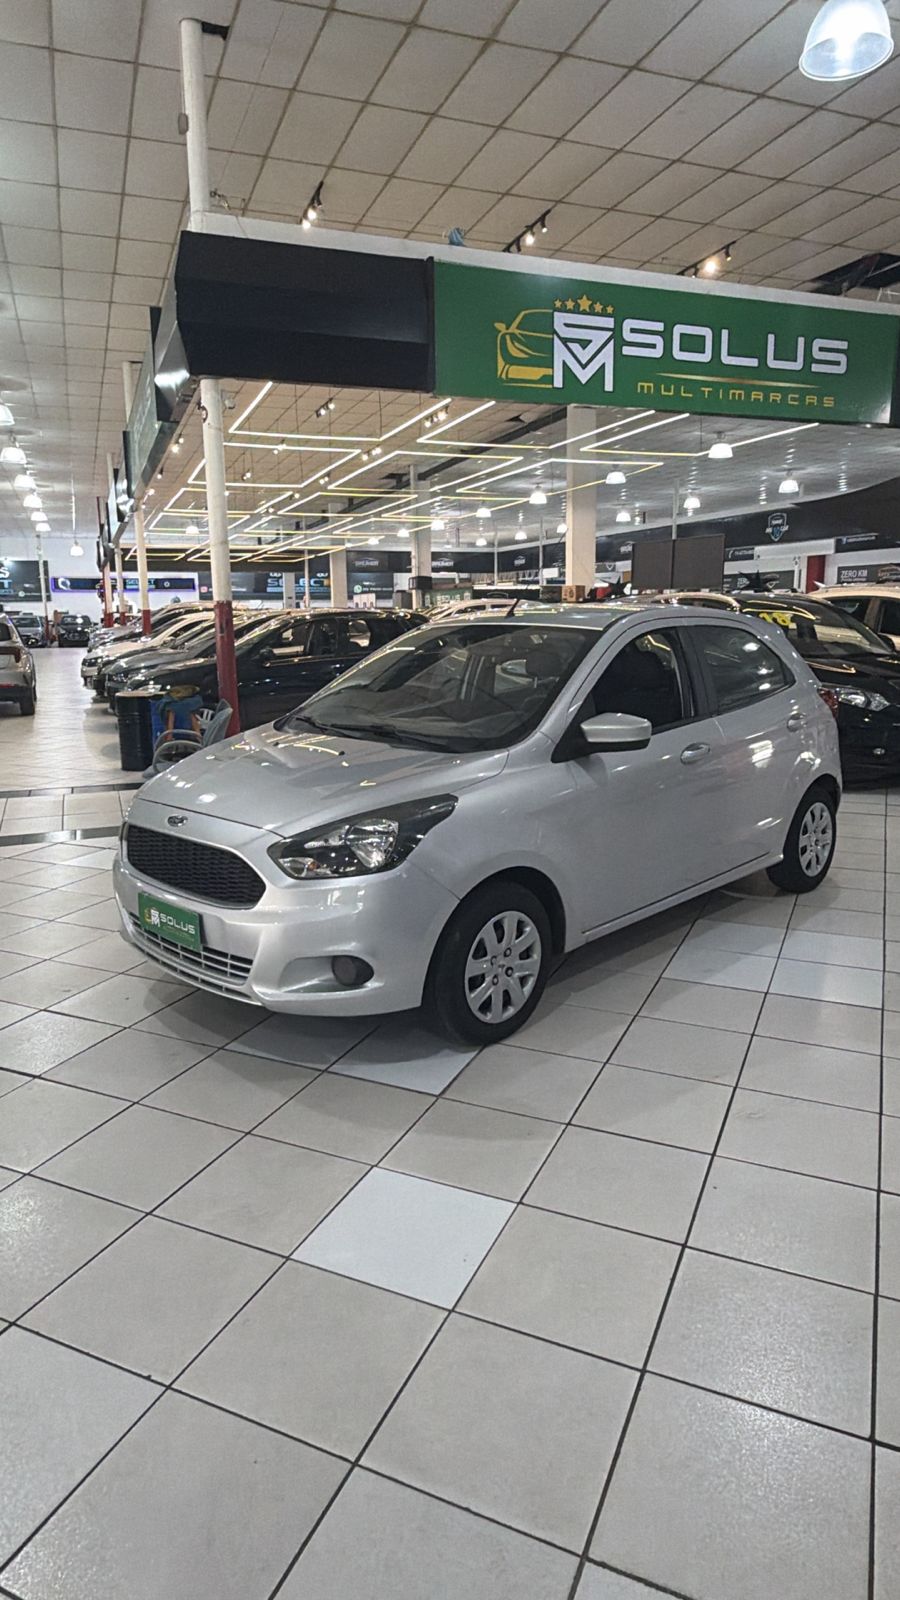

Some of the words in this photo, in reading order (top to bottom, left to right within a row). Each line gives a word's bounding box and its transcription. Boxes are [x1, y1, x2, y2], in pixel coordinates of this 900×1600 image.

[622, 318, 848, 375] SOLUS
[637, 382, 835, 407] MULTIMARCAS
[160, 913, 196, 935] SOLUS
